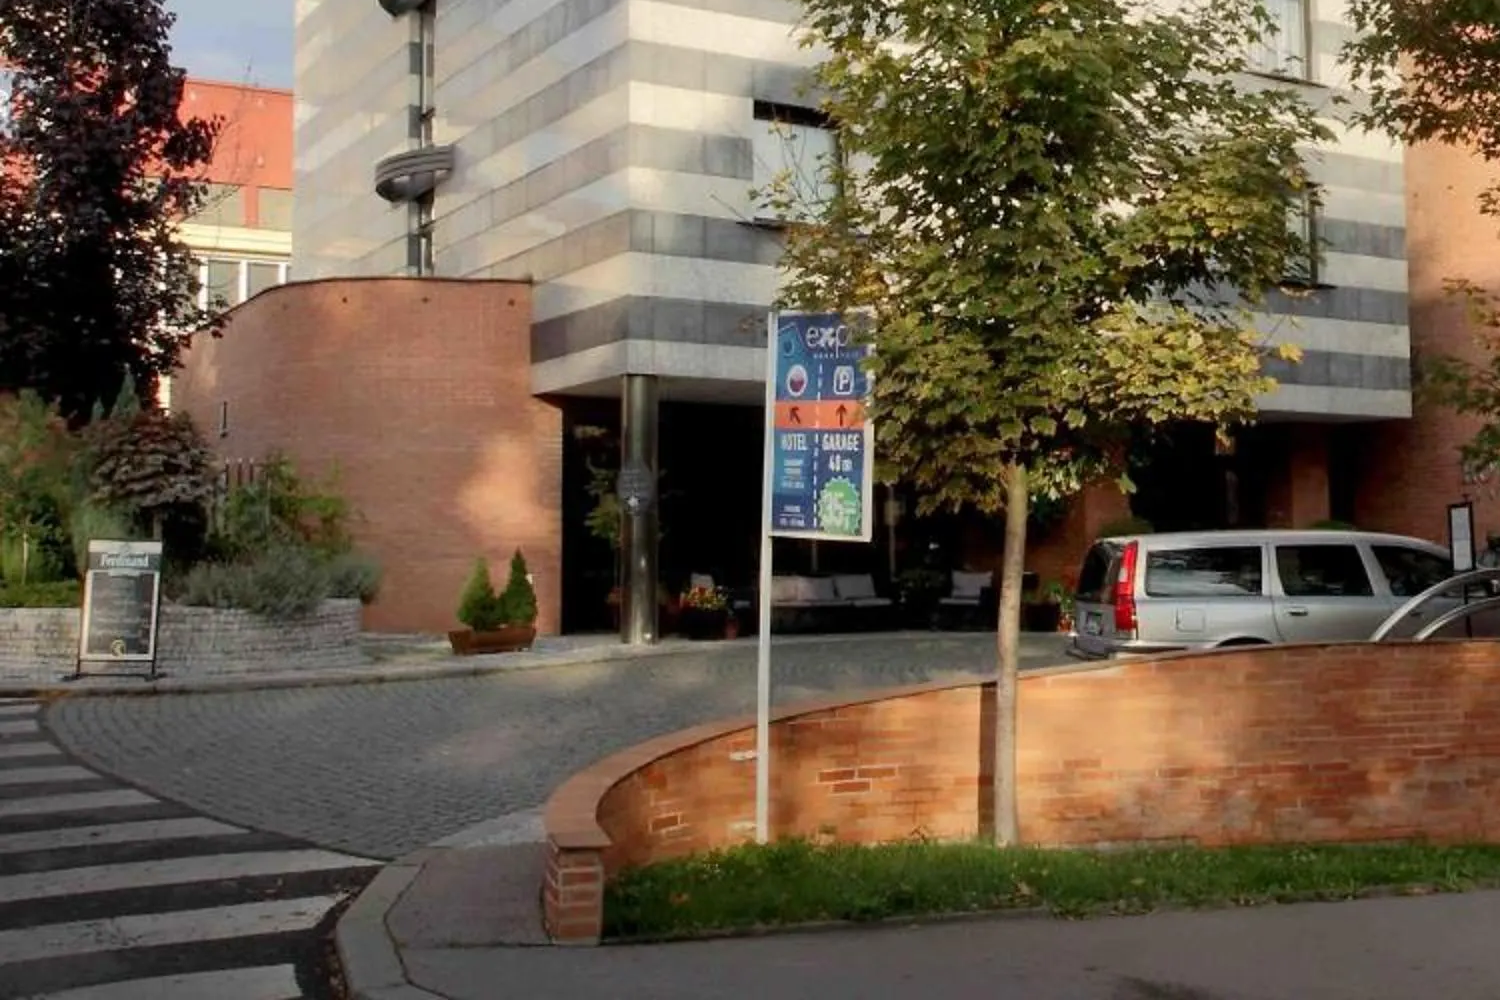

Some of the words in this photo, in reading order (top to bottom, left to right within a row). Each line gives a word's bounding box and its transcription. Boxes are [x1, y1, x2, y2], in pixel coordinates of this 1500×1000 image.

[806, 325, 858, 358] exp
[781, 433, 807, 451] HOTEL
[822, 433, 859, 451] GARAGE
